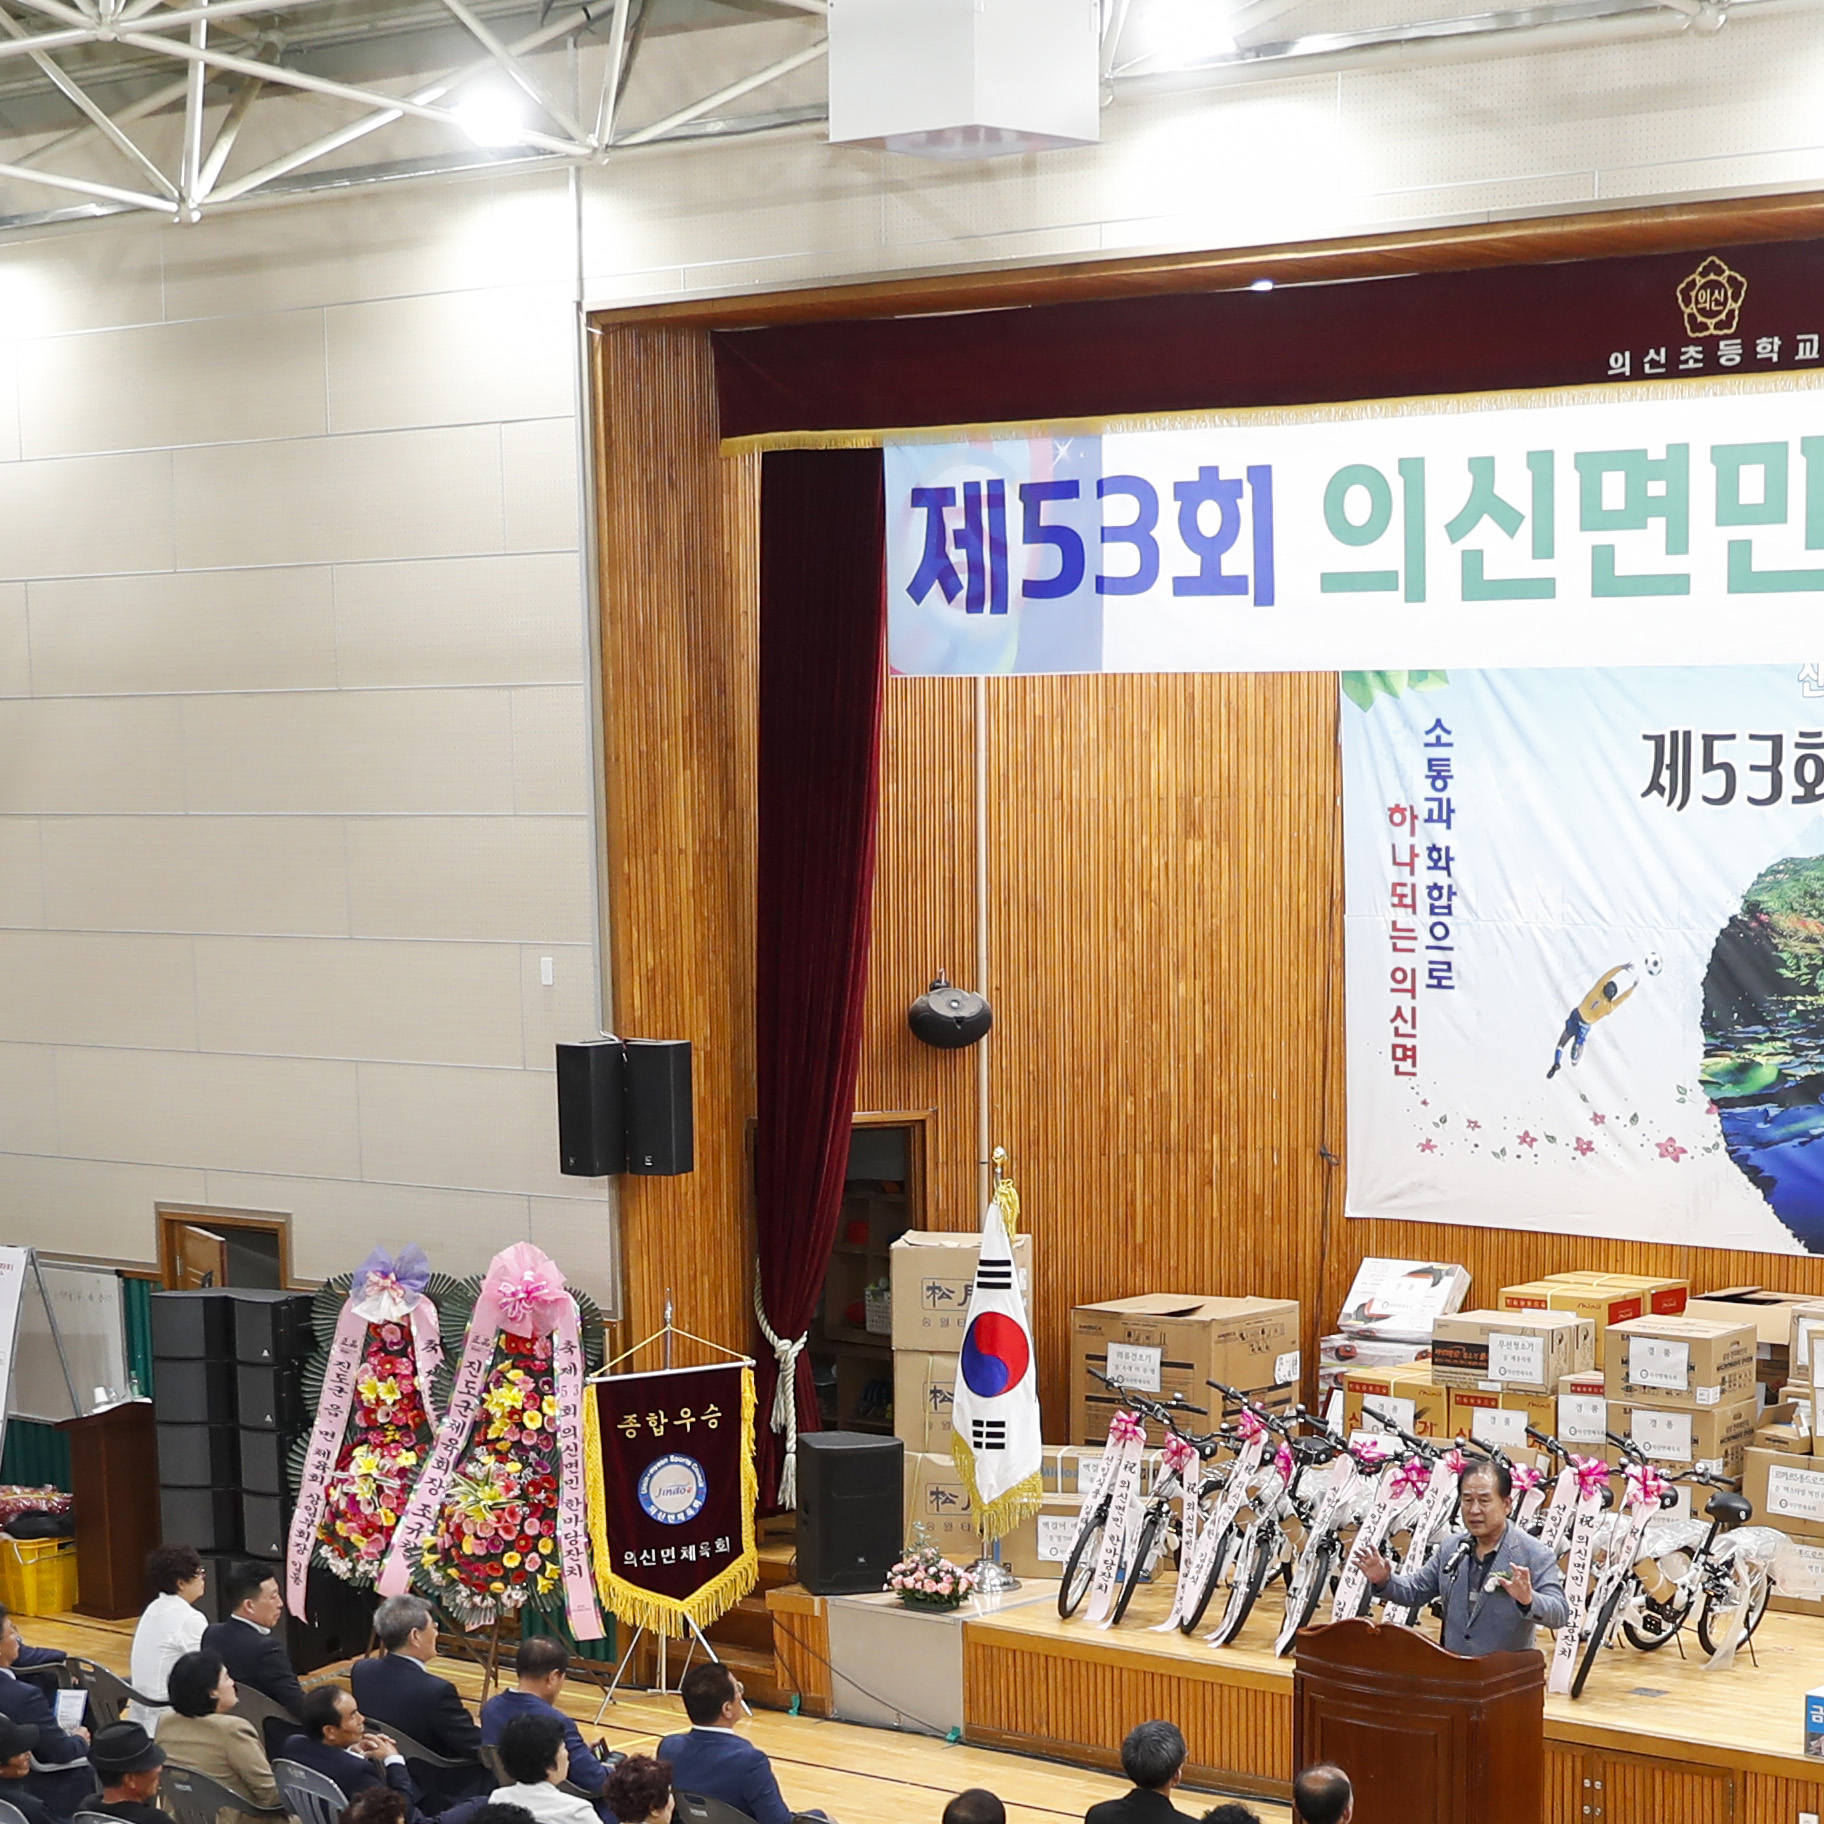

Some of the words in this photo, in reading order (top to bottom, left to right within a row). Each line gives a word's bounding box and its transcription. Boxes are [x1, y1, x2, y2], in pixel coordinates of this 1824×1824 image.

[1697, 288, 1724, 311] 의신
[1607, 333, 1820, 377] 의신초등학교
[906, 462, 1276, 616] 제53회
[1423, 717, 1456, 831] 소통과
[1388, 803, 1420, 953] 하나되는
[1425, 843, 1457, 990] 화합으로
[1389, 966, 1418, 1078] 의신면
[558, 1339, 578, 1356] 축
[328, 1359, 352, 1400] 진도군
[617, 1403, 722, 1439] 종합우승
[561, 1426, 581, 1492] 의신면민
[654, 1484, 688, 1499] Jindo
[562, 1499, 584, 1579] 한마당잔치
[623, 1536, 731, 1568] 의신면체육회
[1573, 1534, 1590, 1588] 의신면민
